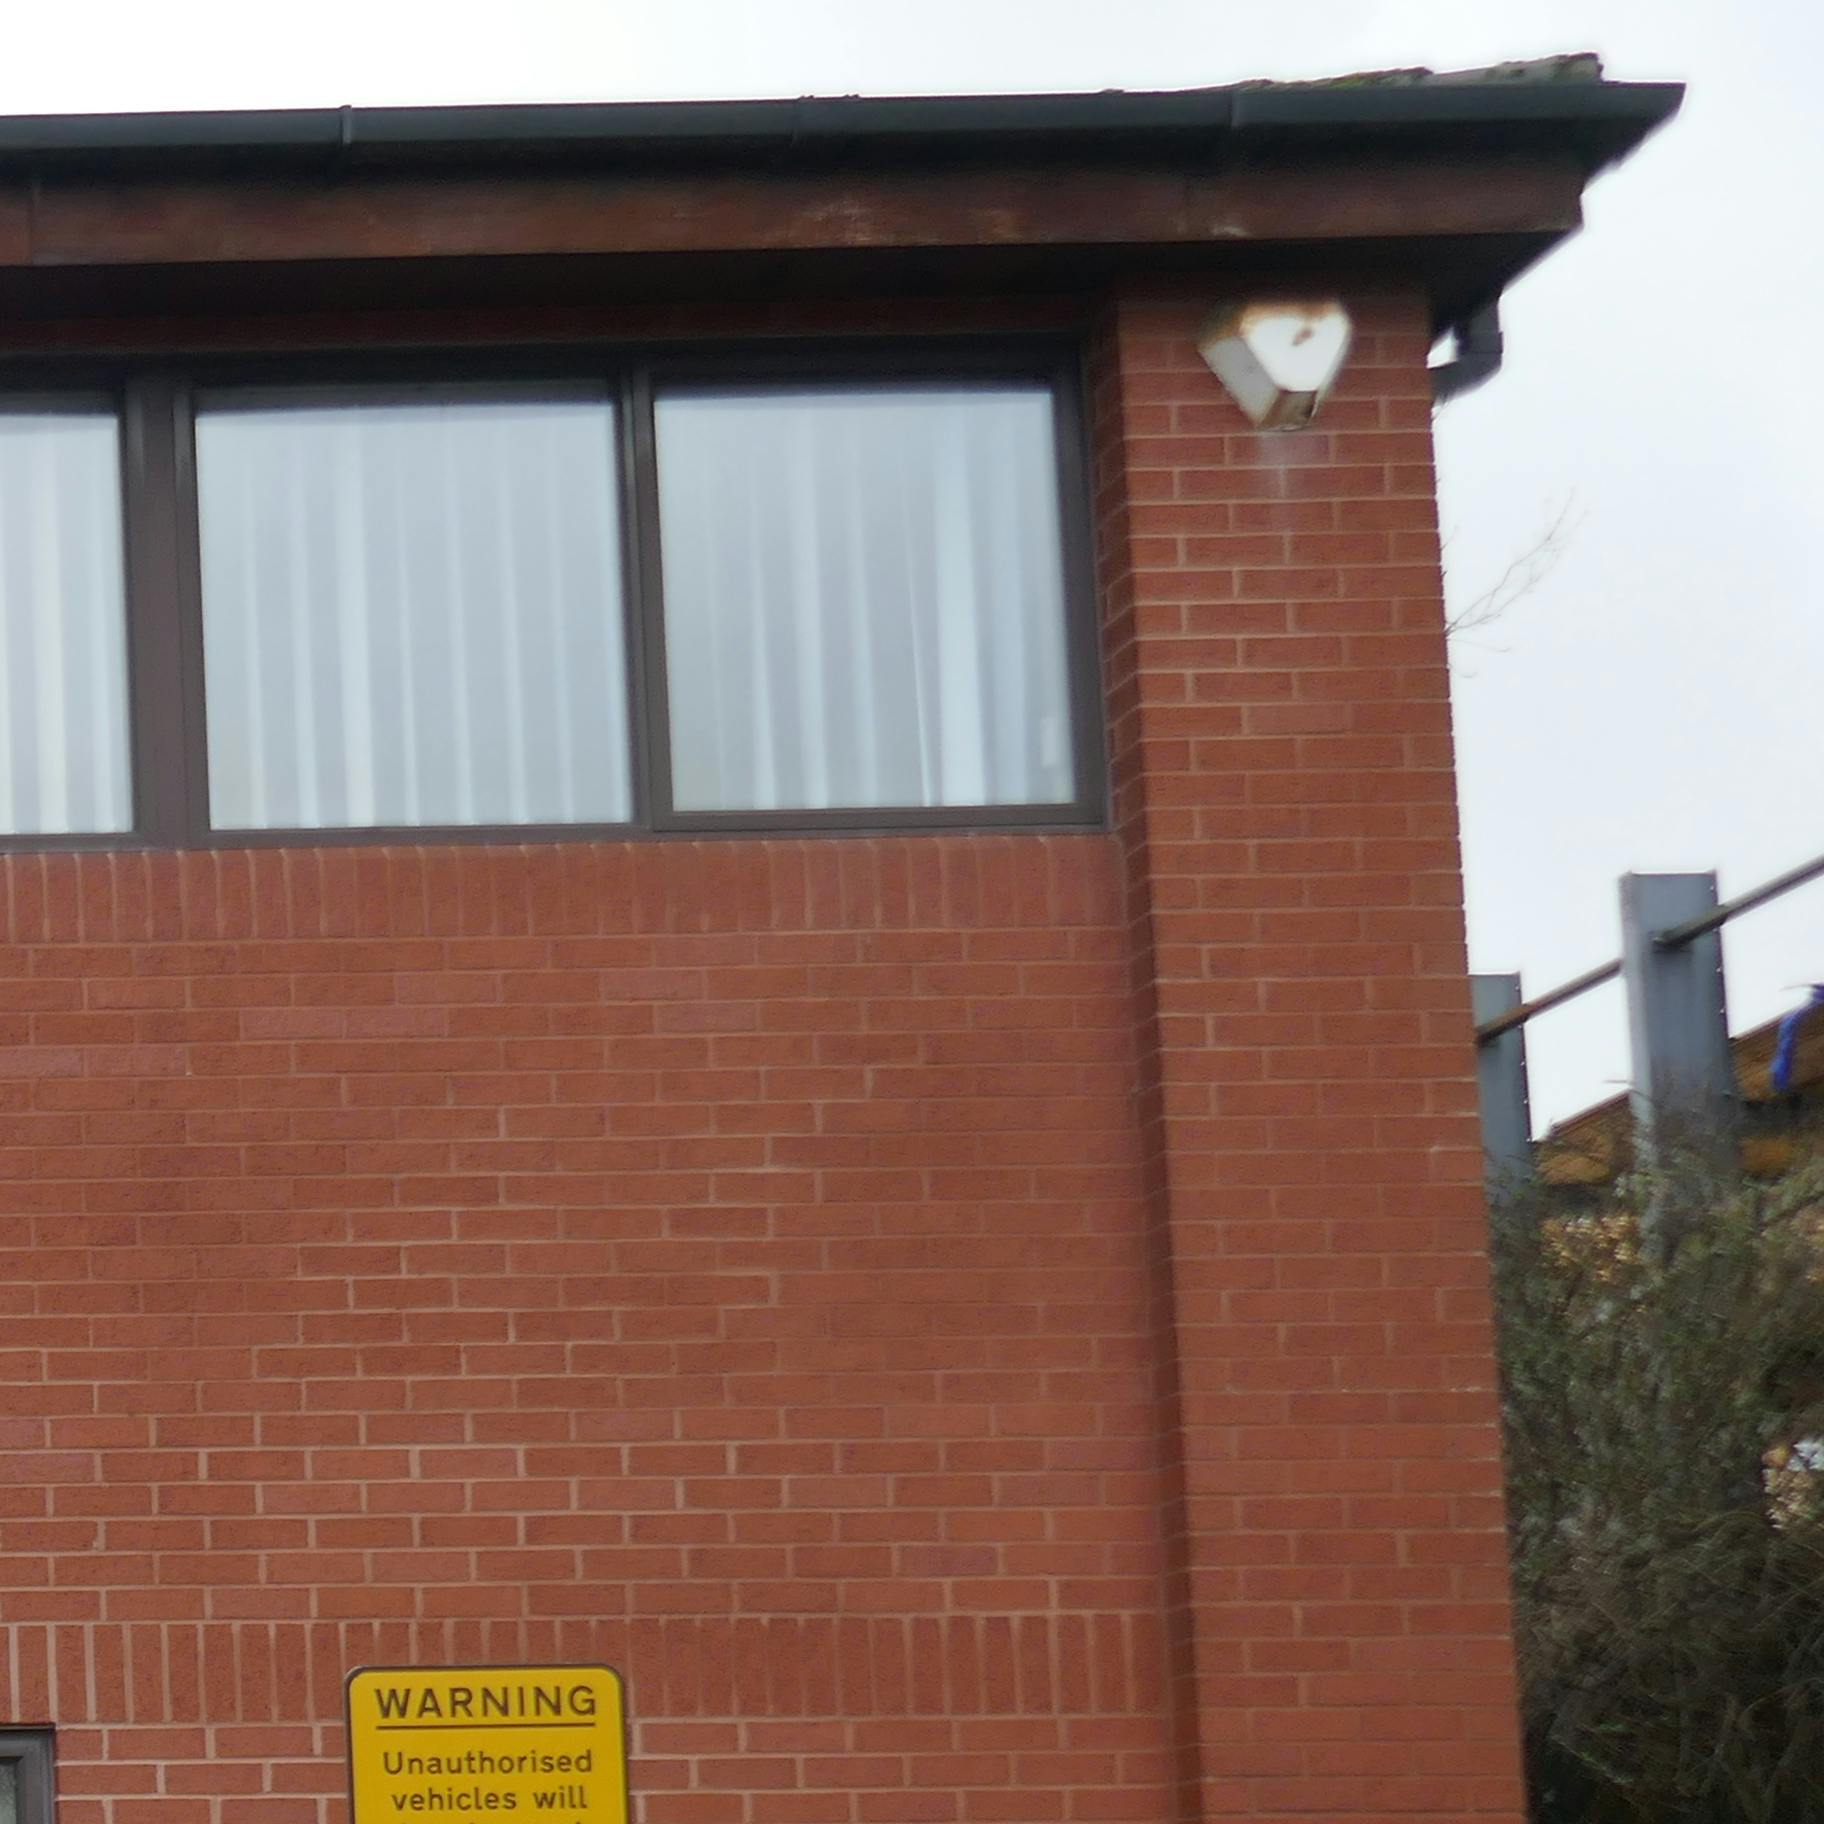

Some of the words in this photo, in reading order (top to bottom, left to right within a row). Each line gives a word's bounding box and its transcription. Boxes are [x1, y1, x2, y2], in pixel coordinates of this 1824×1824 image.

[375, 1686, 596, 1719] WARNING
[383, 1749, 592, 1775] Unauthorised
[392, 1788, 517, 1811] vehicles
[533, 1786, 588, 1809] will
